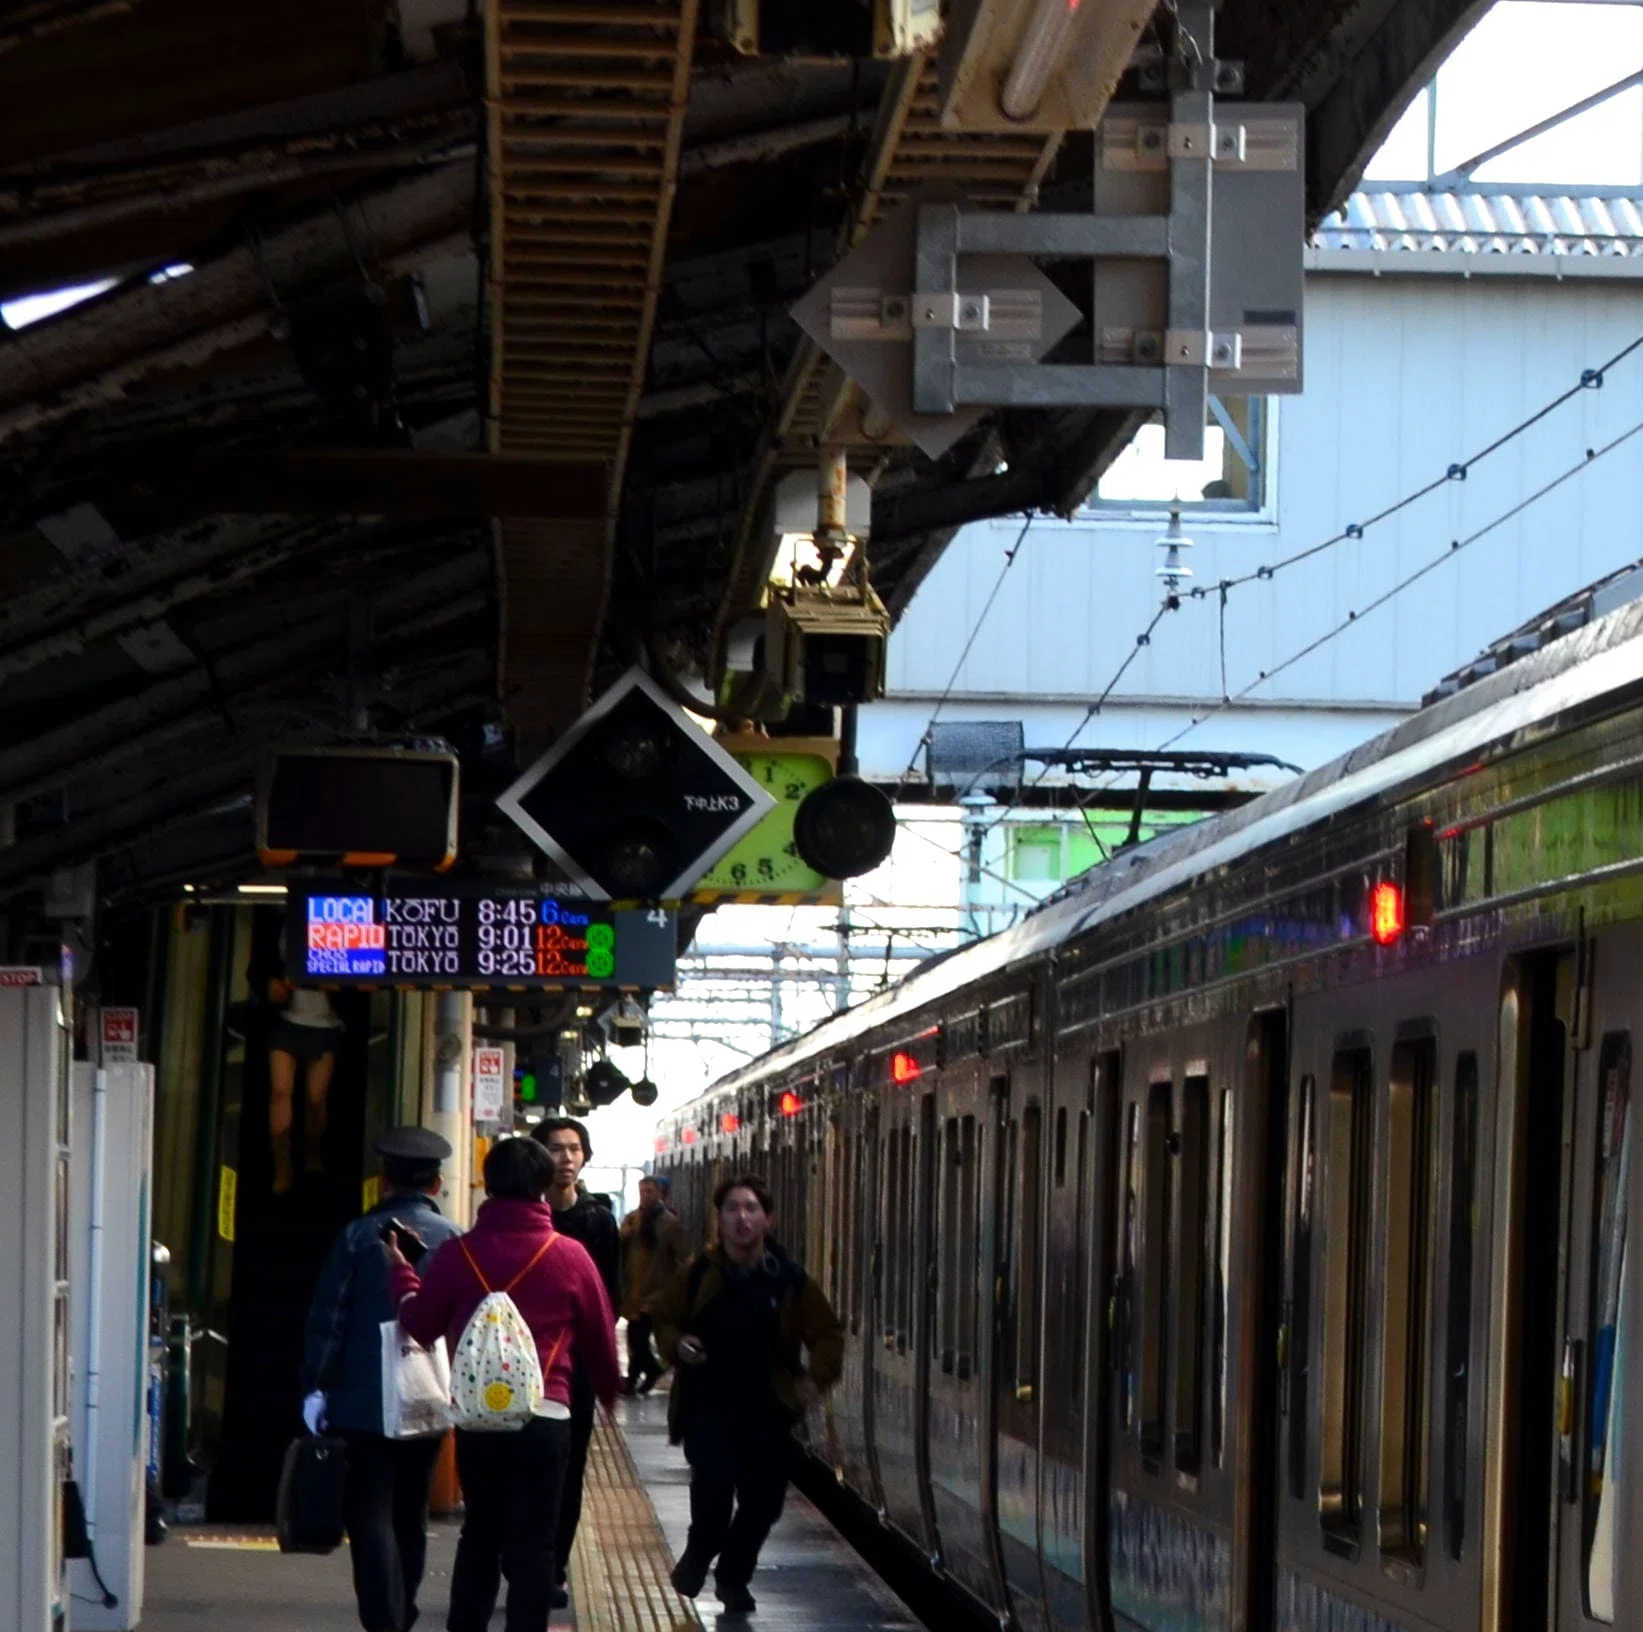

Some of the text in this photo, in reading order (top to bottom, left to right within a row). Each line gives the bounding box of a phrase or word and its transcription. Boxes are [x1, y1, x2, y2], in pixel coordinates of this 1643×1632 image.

[478, 899, 537, 925] 8:45
[646, 908, 668, 929] 4
[308, 923, 385, 949] RAPID
[478, 925, 533, 950] 9:01
[478, 950, 537, 975] 9:25
